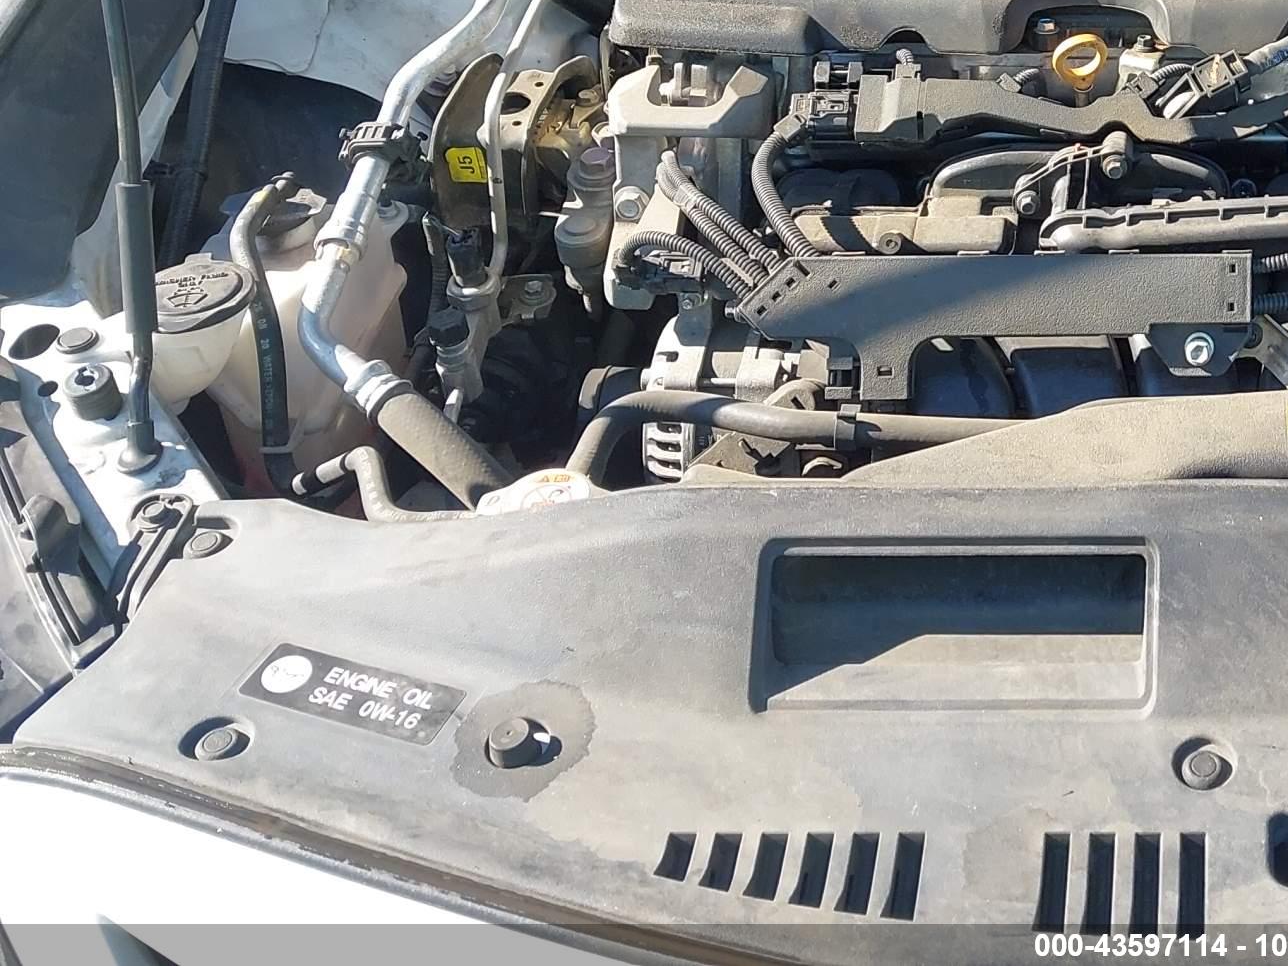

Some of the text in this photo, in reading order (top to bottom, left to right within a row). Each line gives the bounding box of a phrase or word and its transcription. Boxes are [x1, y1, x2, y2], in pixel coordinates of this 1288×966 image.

[457, 155, 475, 174] J5
[308, 686, 422, 730] SAE 0W-16
[323, 666, 433, 710] ENGINE OIL
